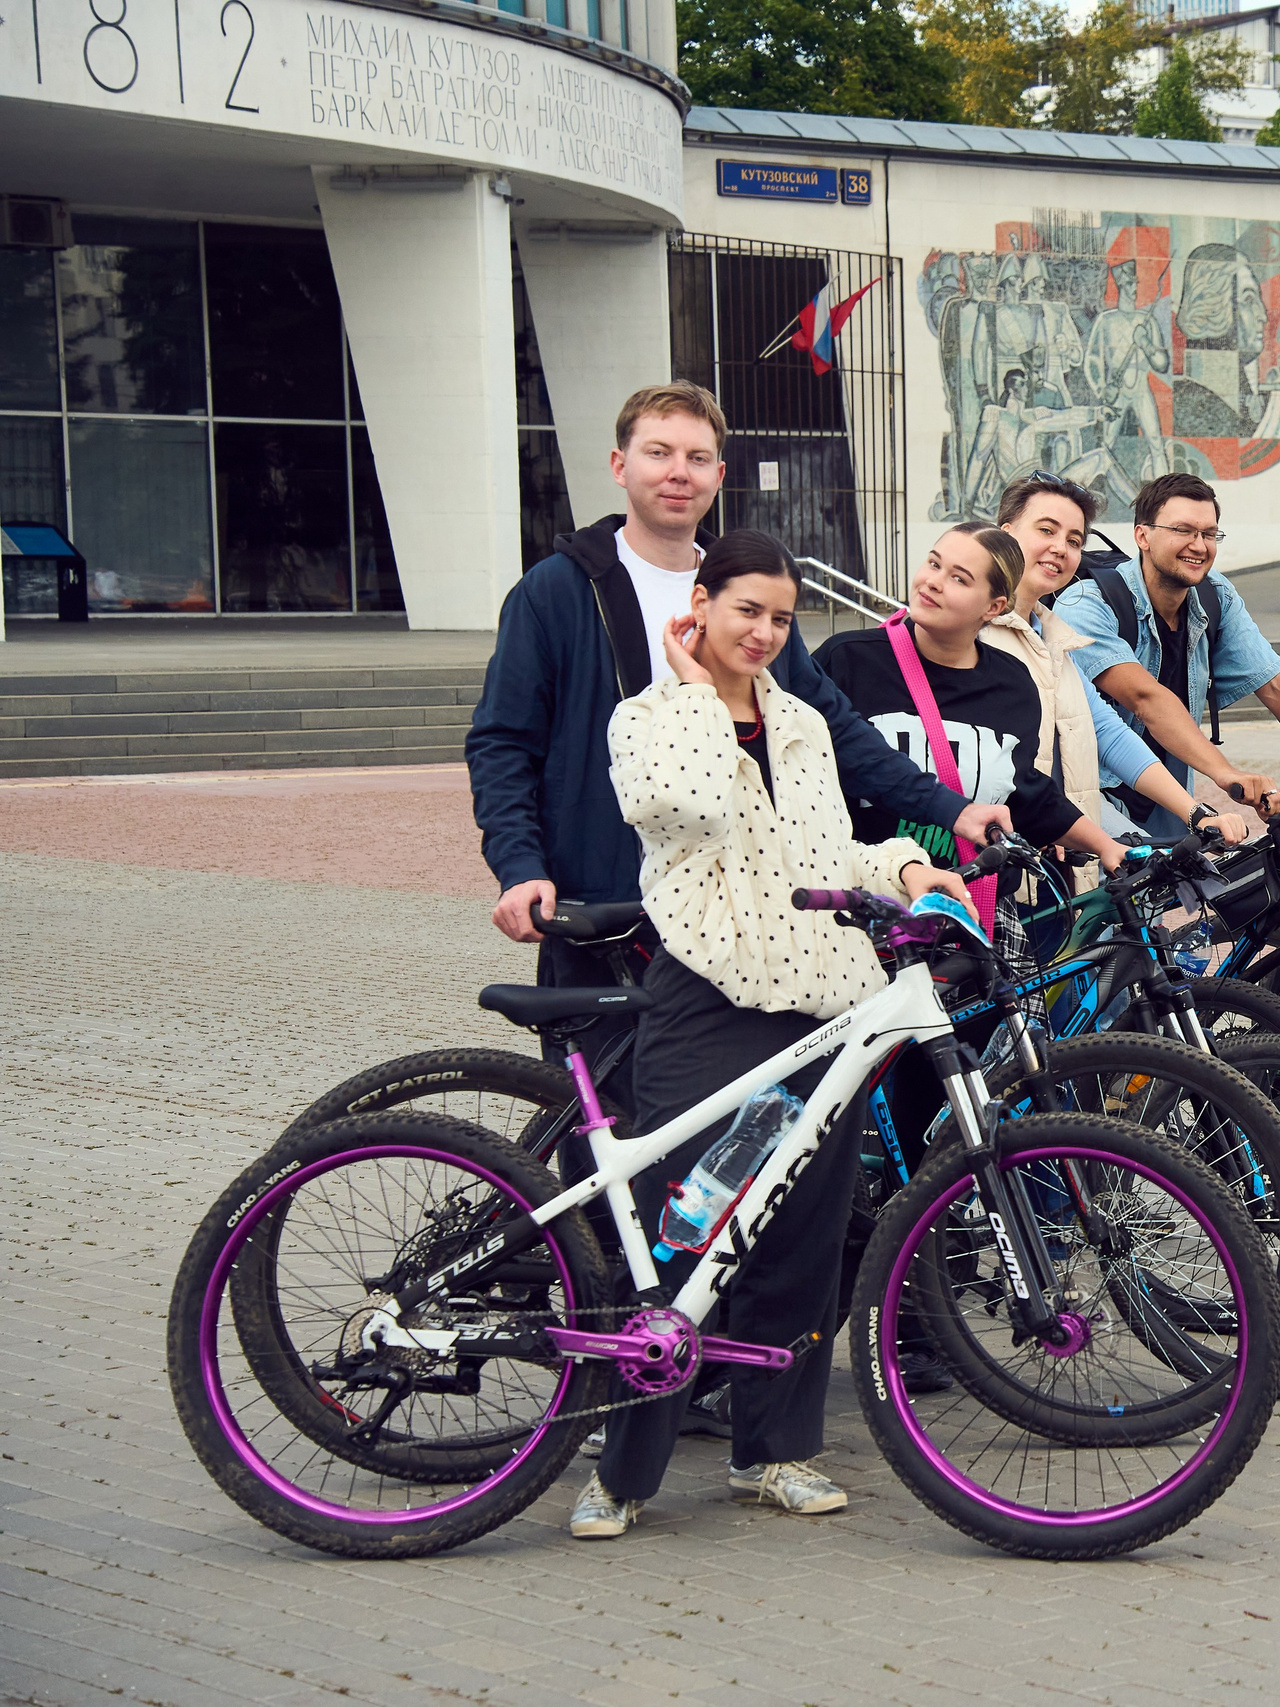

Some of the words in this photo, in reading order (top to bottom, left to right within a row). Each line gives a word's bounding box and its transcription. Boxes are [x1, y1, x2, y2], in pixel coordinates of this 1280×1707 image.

[32, 0, 260, 113] 1812
[306, 13, 417, 65] МИХАИЛ
[428, 35, 521, 86] КУТУЗОВ
[542, 62, 598, 109] МАТВЕЙ
[601, 82, 645, 125] ПЛАТОВ
[309, 51, 378, 95] ПЕТР
[390, 65, 517, 121] БАГРАТИОН
[538, 95, 607, 144] НИКОЛАЙ
[310, 89, 428, 140] БАРКЛАЙ
[436, 109, 464, 145] ДЕ
[468, 115, 538, 160] ТОЛЛИ
[558, 135, 629, 183] АЛЕКСАНДР
[741, 168, 818, 185] КУТУЗОВСКИЙ
[761, 184, 800, 193] ПРОСПЕКТ
[848, 175, 869, 194] 38
[346, 1088, 382, 1114] CST
[386, 1070, 469, 1095] PATROL
[226, 1194, 257, 1228] CHAO
[264, 1160, 301, 1185] YANG
[427, 1233, 505, 1293] STELS
[868, 1306, 879, 1346] YANG
[867, 1353, 888, 1401] CHAO
